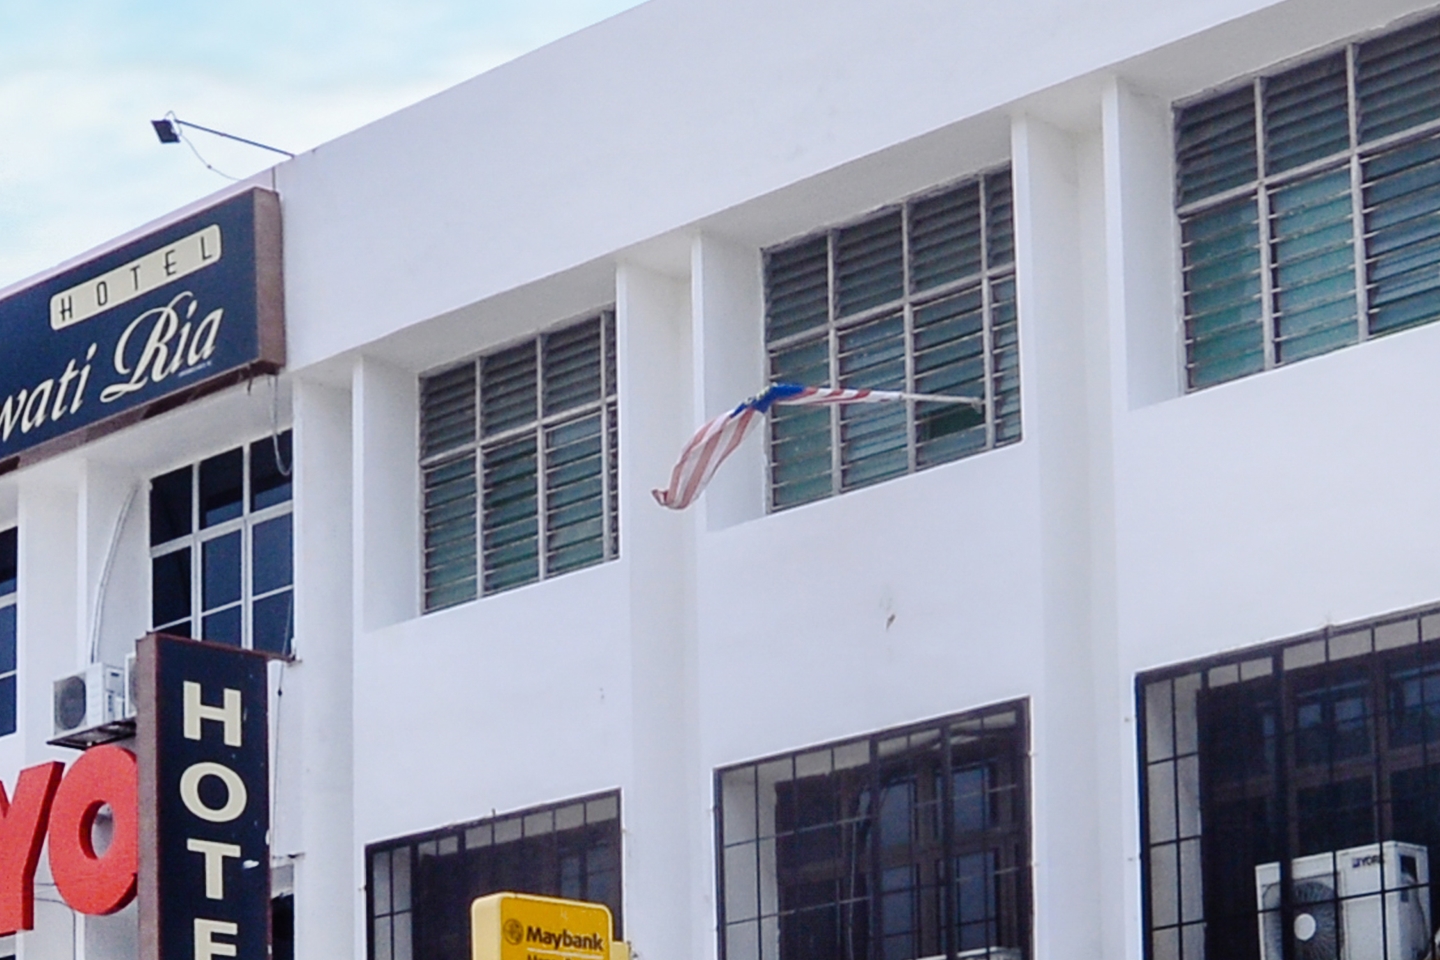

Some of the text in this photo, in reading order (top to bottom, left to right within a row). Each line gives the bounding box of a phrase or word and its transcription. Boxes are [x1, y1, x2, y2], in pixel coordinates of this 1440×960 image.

[59, 236, 214, 322] HOTEL
[100, 290, 224, 404] Ria
[526, 925, 604, 951] Maybank
